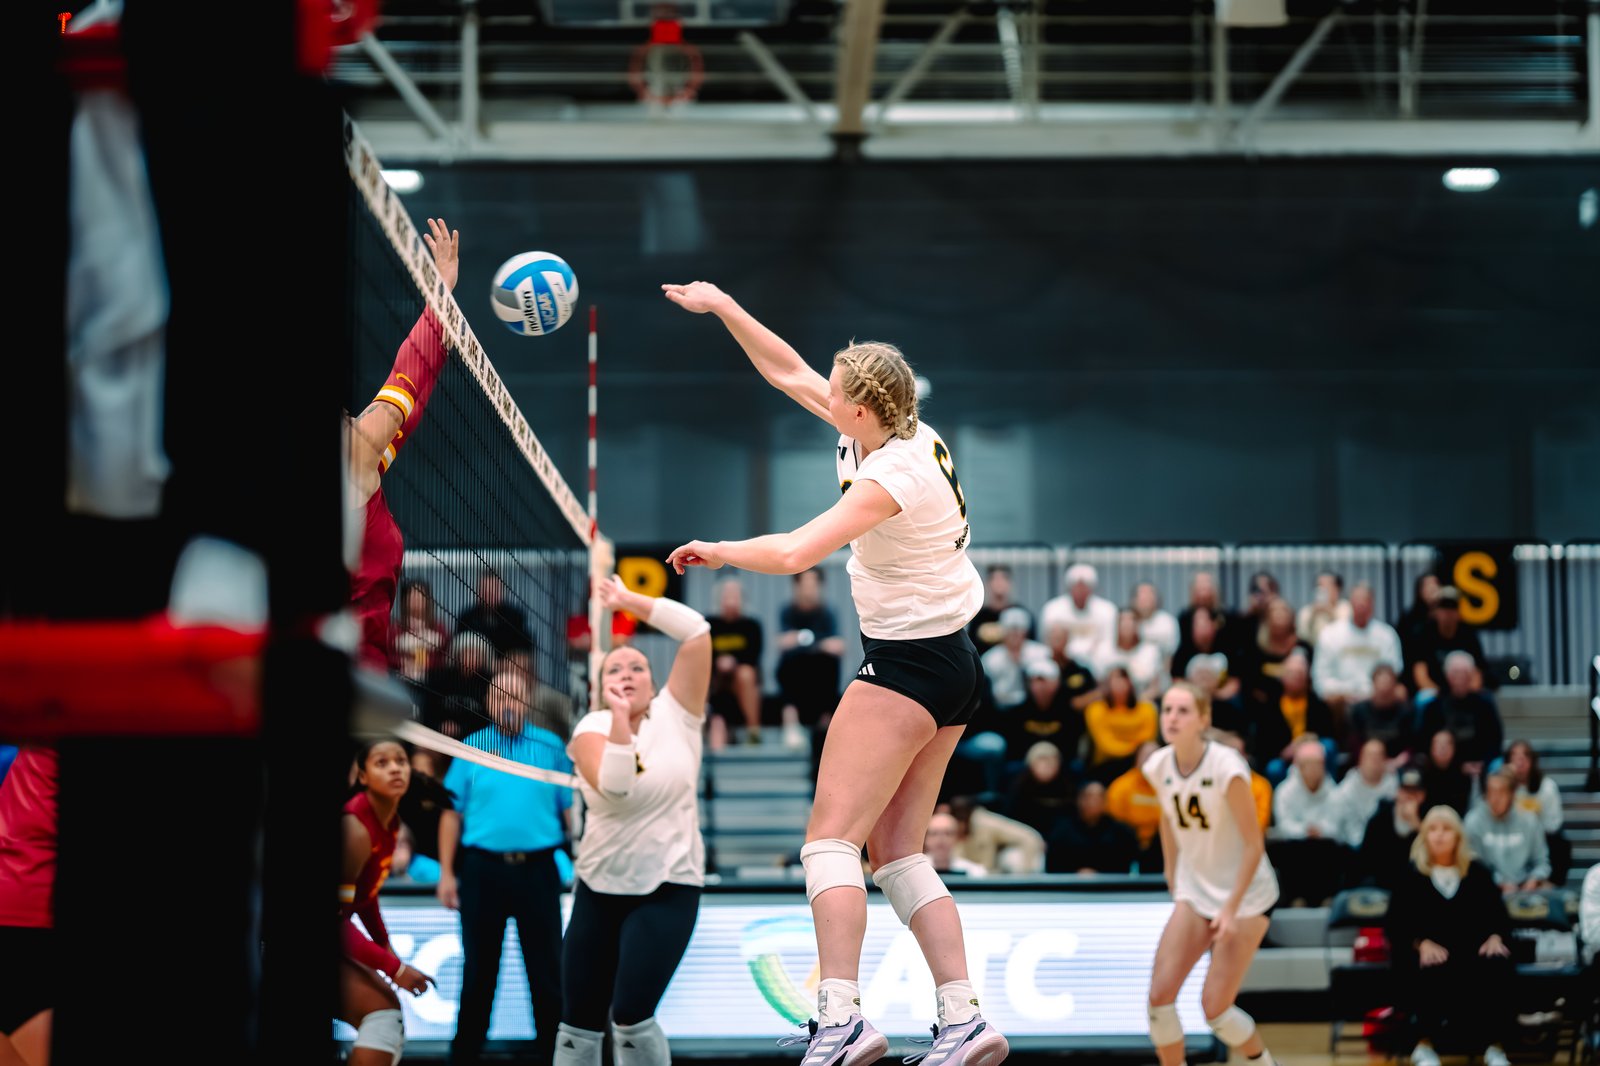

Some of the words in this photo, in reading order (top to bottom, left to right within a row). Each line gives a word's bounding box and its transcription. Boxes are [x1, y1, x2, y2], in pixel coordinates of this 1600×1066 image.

[523, 291, 540, 331] molten
[536, 292, 557, 326] NCAA
[1453, 551, 1499, 625] S
[1172, 794, 1210, 829] 14
